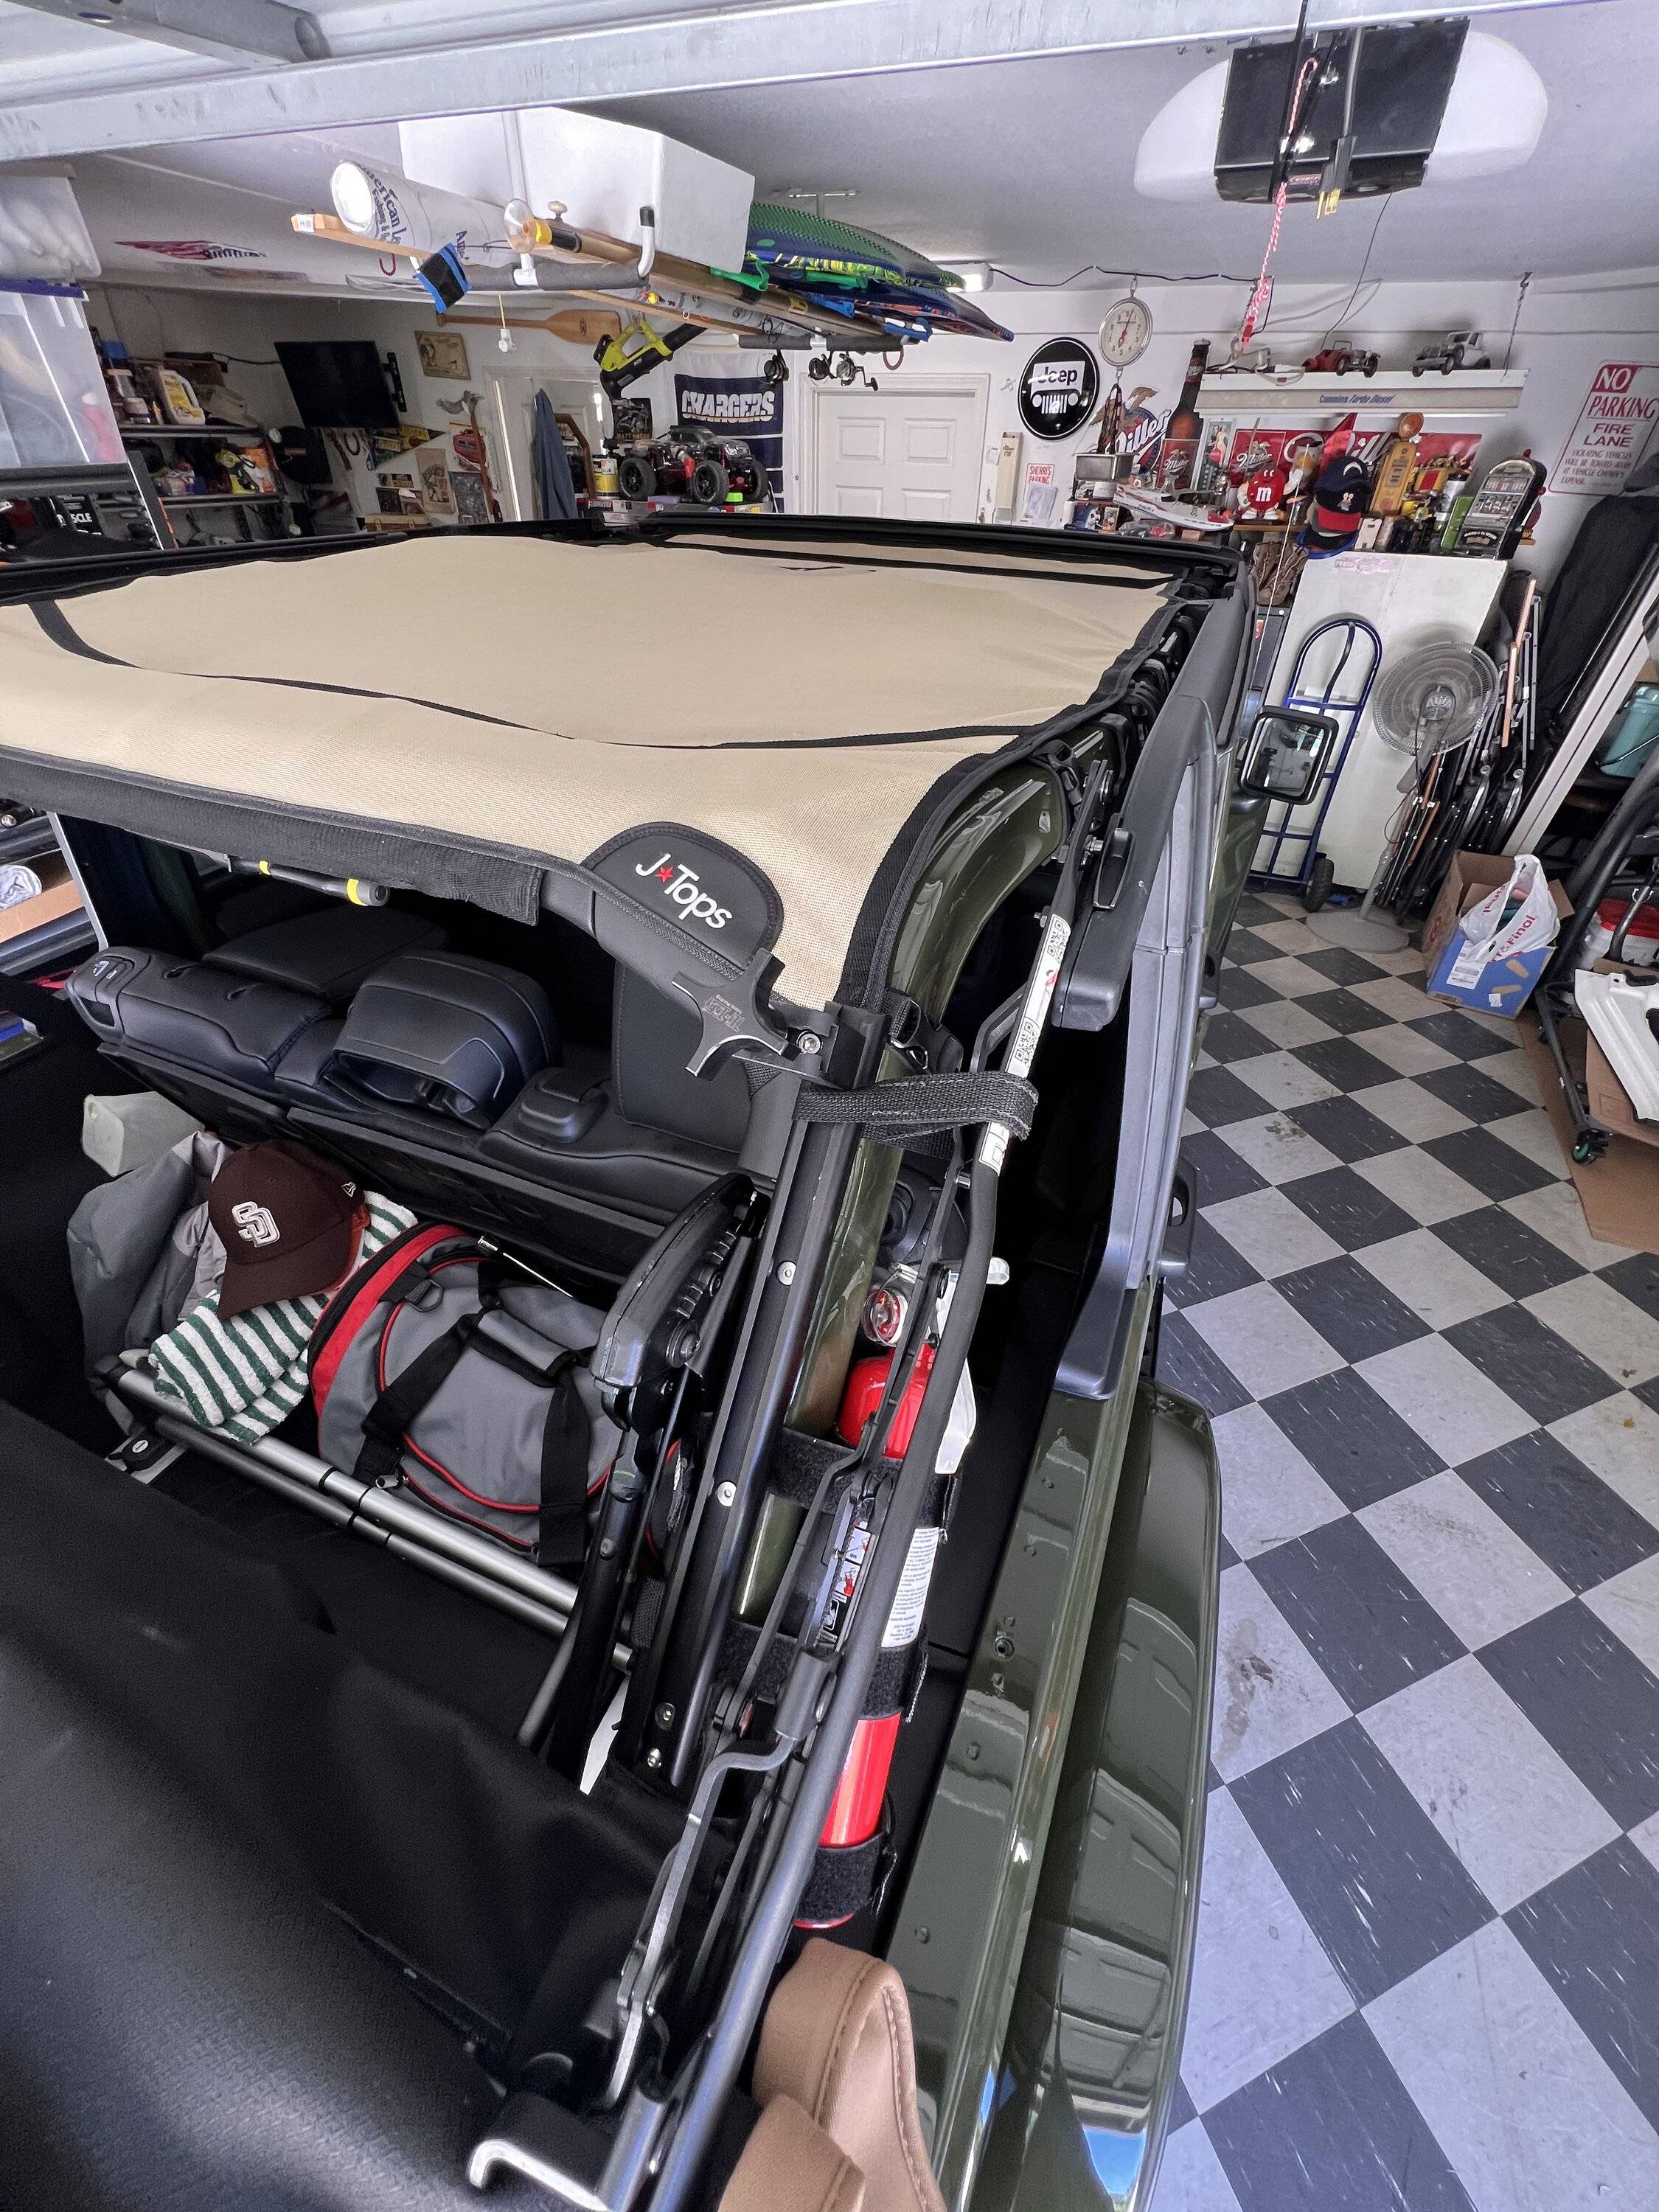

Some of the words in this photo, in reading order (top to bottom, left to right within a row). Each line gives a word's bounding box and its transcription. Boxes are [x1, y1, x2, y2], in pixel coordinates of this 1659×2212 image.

[1038, 366, 1078, 386] Jeep
[1596, 368, 1632, 390] NO
[681, 390, 776, 424] CHARGERS
[1587, 396, 1659, 419] PARKING
[1593, 422, 1635, 435] FIRE
[1583, 435, 1633, 448] LANE
[1029, 465, 1051, 476] SHERRI'S
[1029, 476, 1050, 485] PARKING
[664, 863, 733, 929] Tops
[232, 1201, 281, 1248] SD
